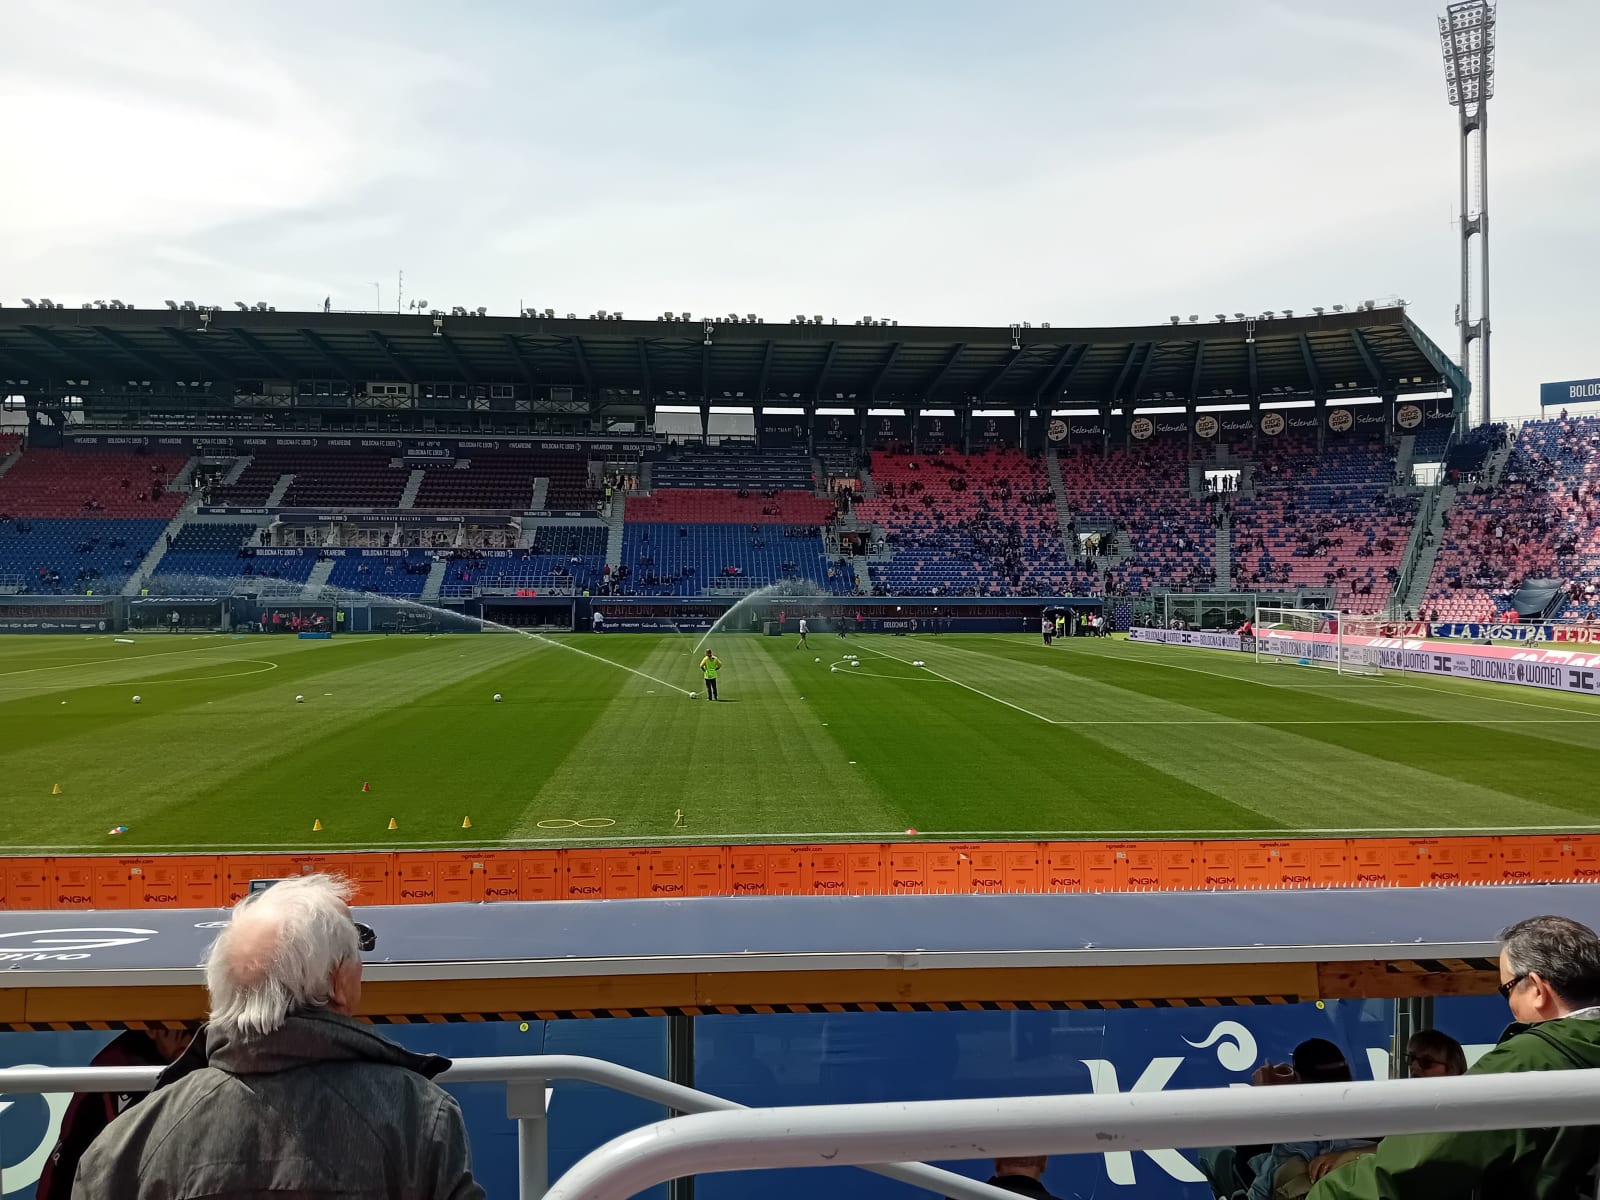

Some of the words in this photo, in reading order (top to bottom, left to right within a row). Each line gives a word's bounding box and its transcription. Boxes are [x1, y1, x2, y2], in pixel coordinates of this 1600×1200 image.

[1570, 384, 1600, 398] BOLOG
[1157, 424, 1188, 432] Selenella
[1449, 624, 1472, 639] LA
[1478, 624, 1546, 641] NOSTRA
[1404, 652, 1430, 670] WOMEN
[1470, 658, 1508, 679] BOLOGNA
[1508, 663, 1515, 674] FC
[1526, 664, 1562, 686] WOMEN
